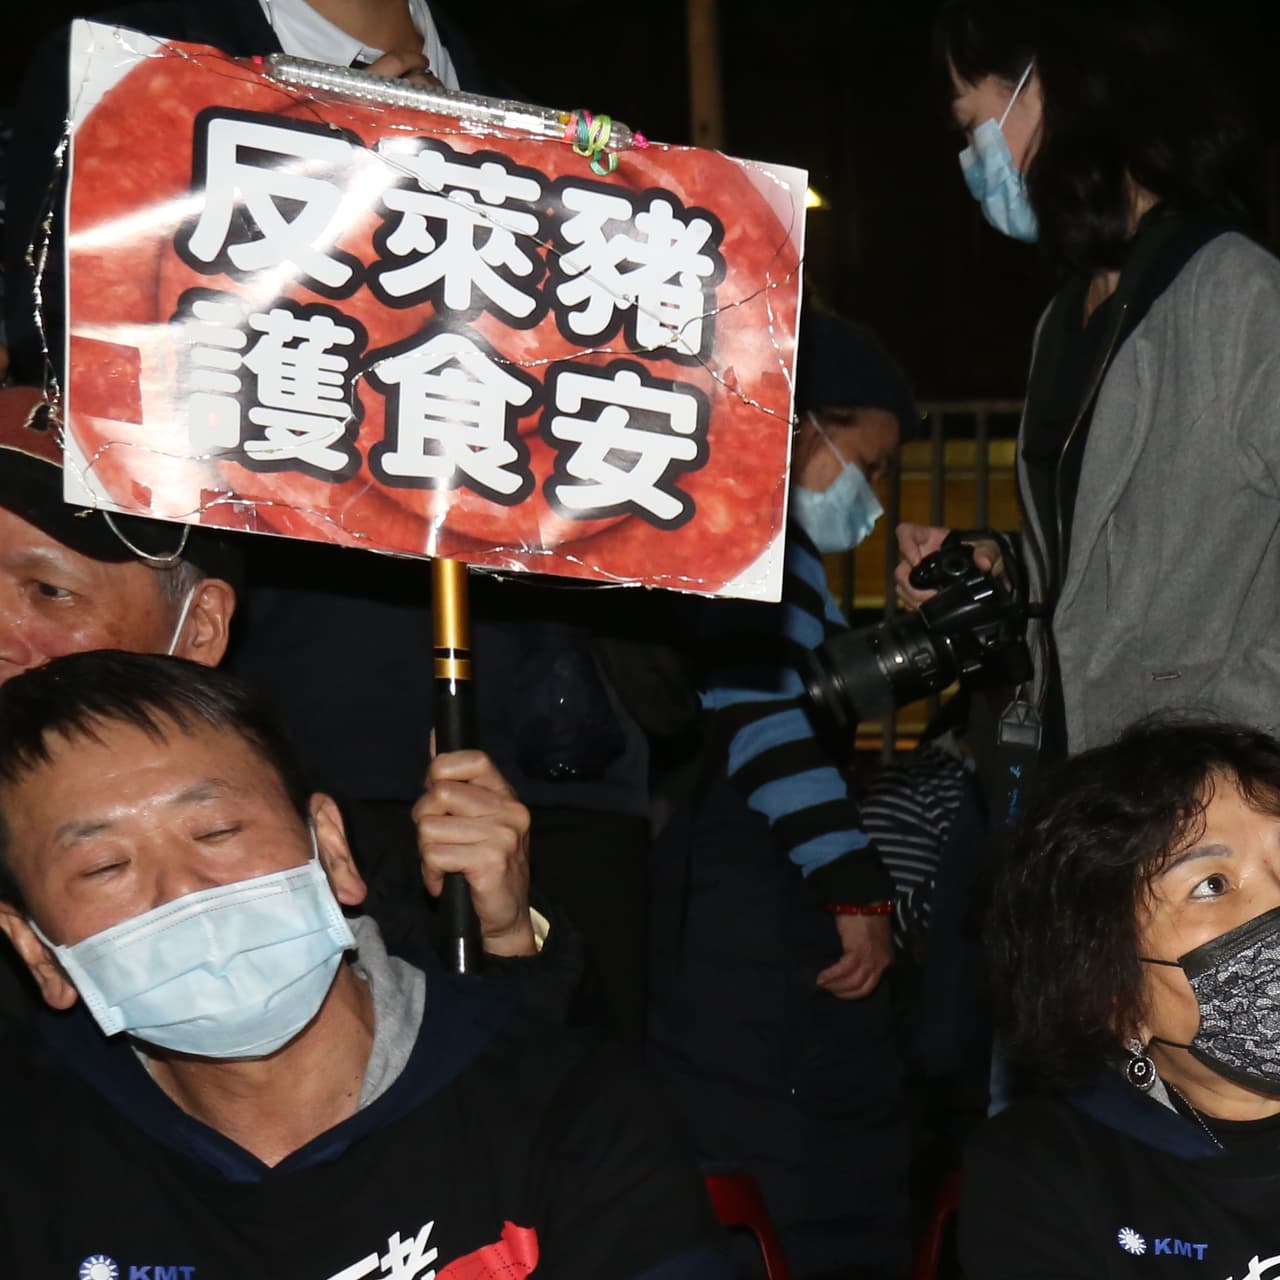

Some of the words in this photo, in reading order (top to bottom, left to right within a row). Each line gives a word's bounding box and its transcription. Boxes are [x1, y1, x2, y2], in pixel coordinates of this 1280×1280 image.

[182, 112, 720, 360] 反萊豬
[182, 296, 704, 523] 護食安
[1154, 1238, 1209, 1261] KMT
